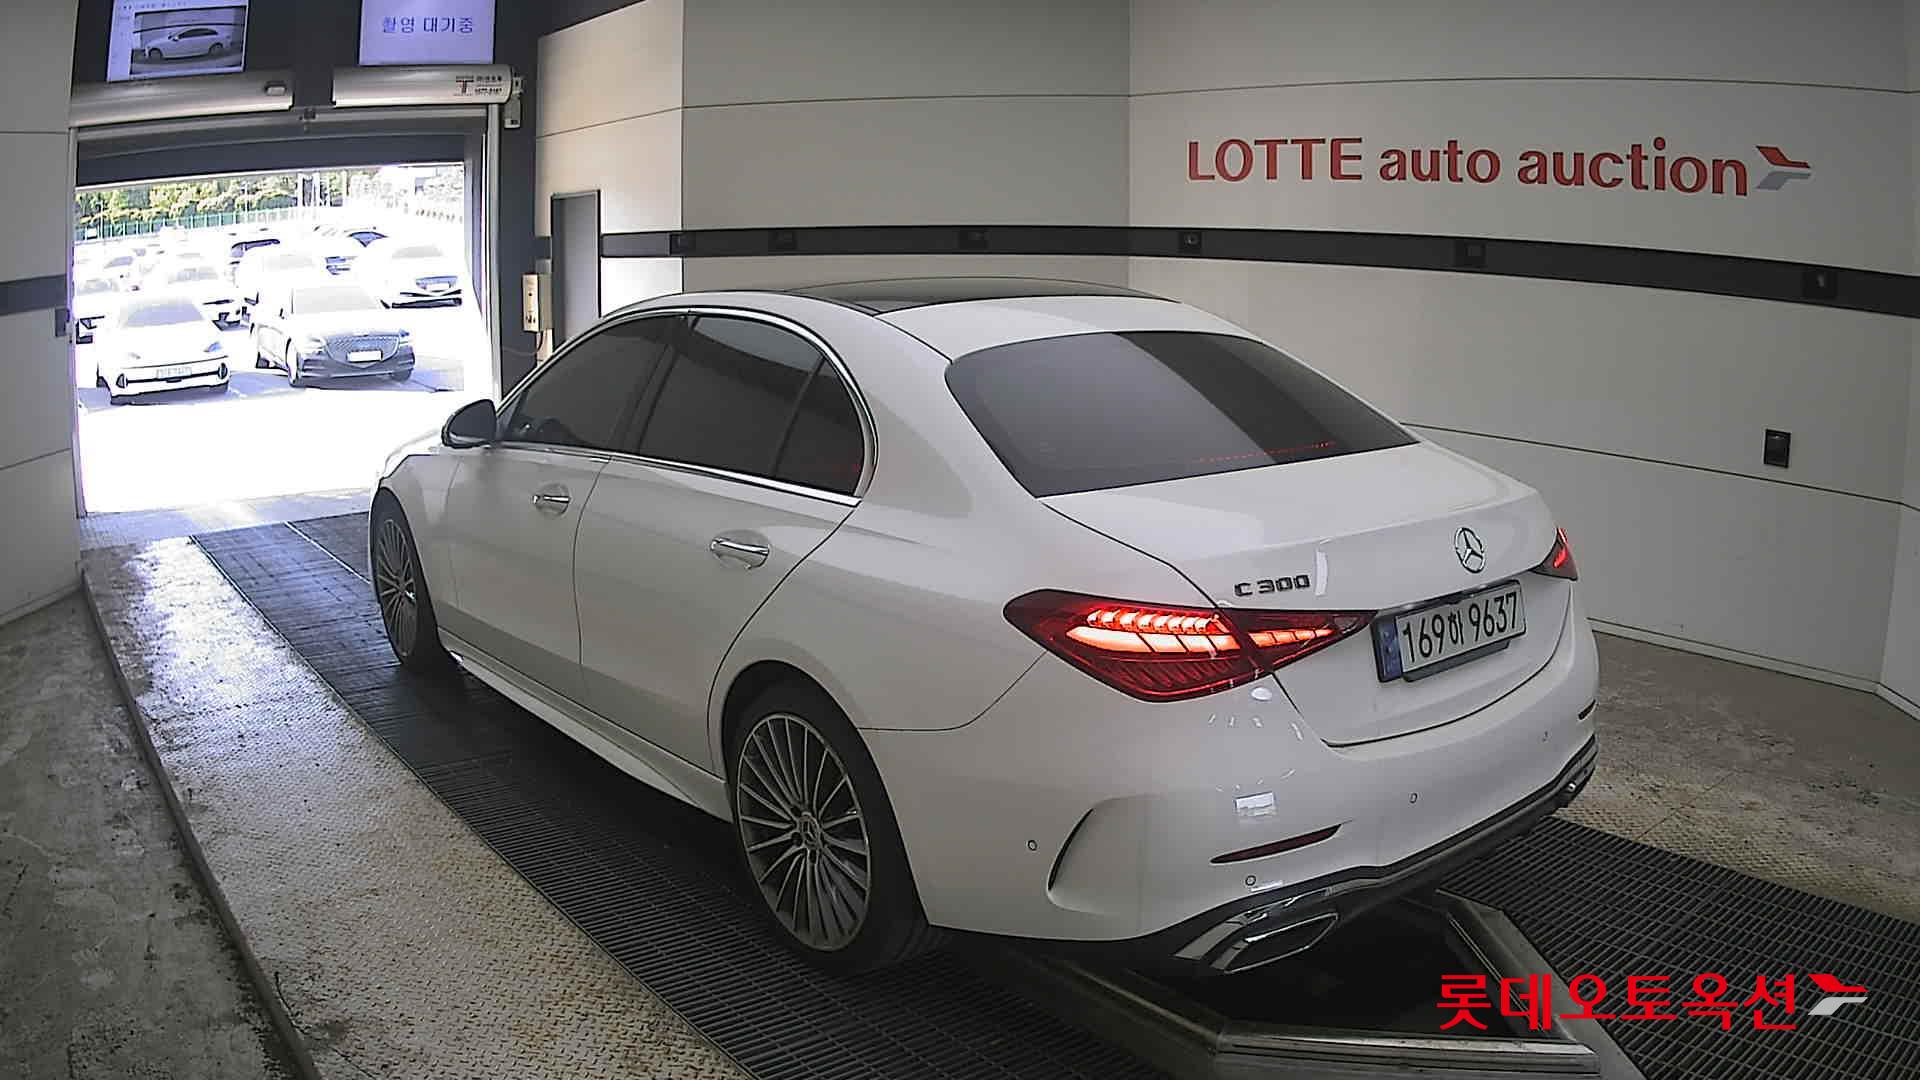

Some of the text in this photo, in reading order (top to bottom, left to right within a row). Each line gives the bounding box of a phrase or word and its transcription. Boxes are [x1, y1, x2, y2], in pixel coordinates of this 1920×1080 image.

[423, 16, 473, 33] 대기중
[1187, 136, 1748, 197] LOTTE auto auction
[1235, 575, 1310, 597] C 300
[1468, 590, 1518, 642] 9637
